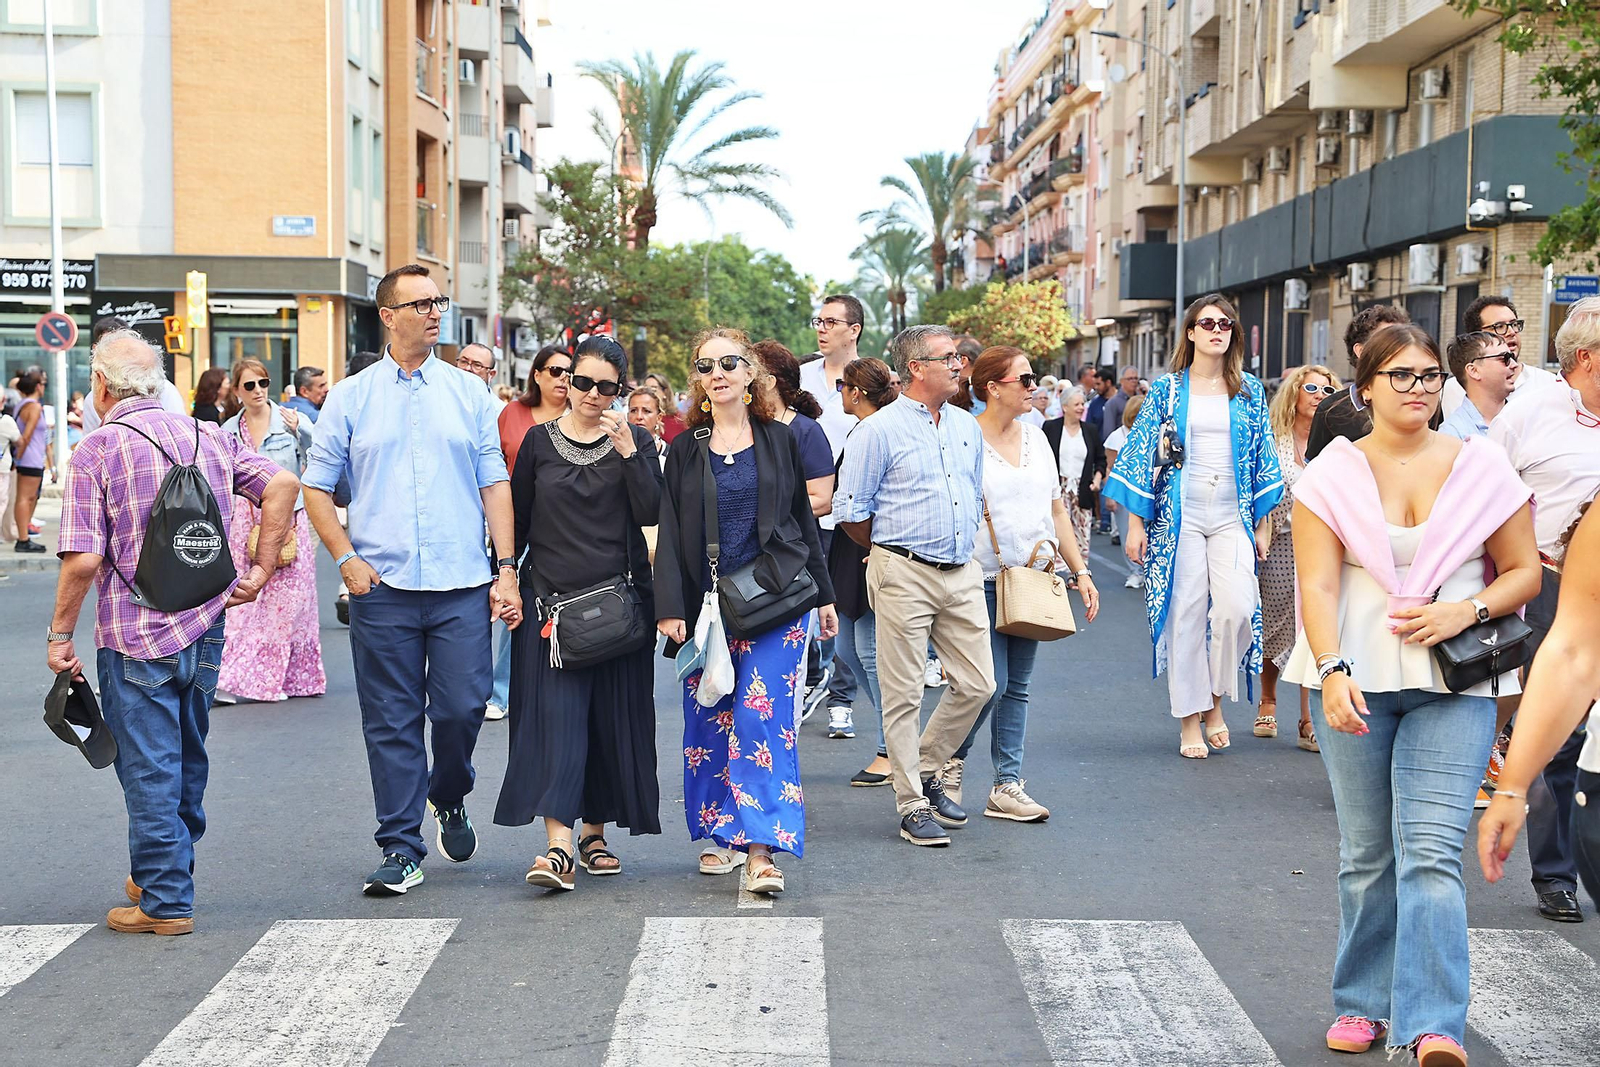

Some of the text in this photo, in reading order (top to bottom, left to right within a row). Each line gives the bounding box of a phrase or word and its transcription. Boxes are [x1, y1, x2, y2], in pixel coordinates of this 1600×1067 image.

[2, 272, 29, 287] 959
[182, 525, 193, 534] HAM
[199, 552, 215, 564] QUALITY
